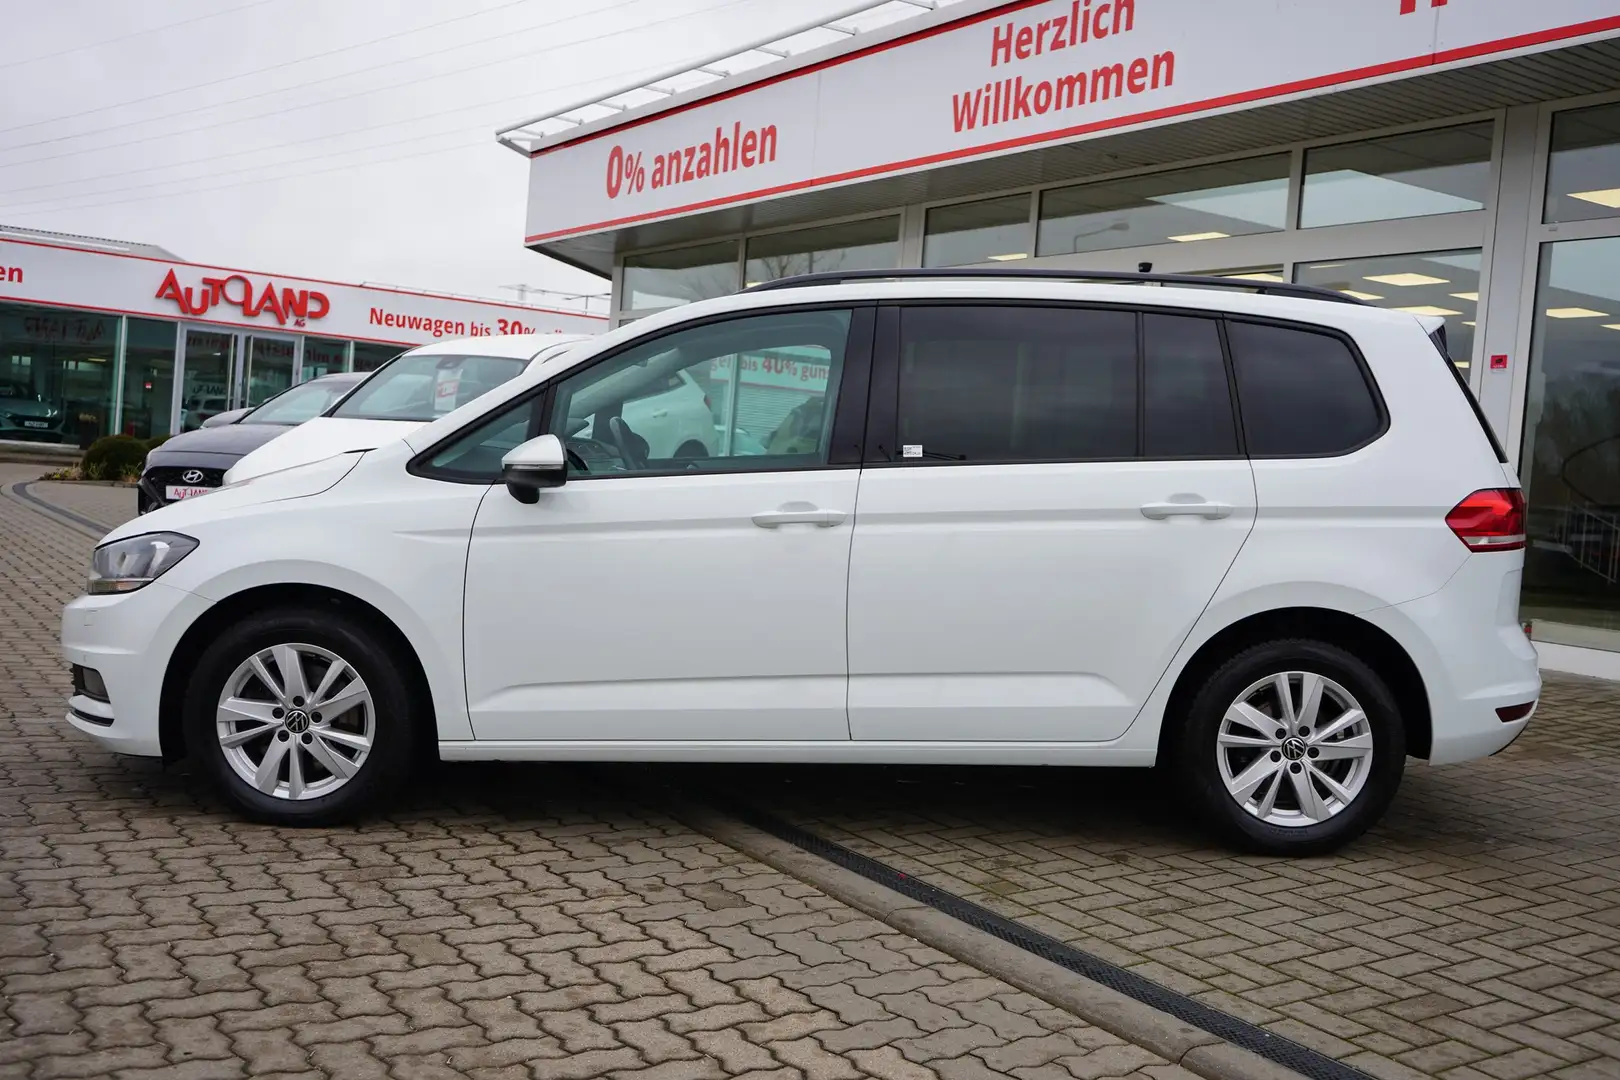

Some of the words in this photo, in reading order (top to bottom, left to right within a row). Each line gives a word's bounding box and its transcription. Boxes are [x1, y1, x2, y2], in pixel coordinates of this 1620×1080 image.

[991, 0, 1136, 67] Herzlich
[952, 50, 1175, 133] Willkommen
[606, 145, 645, 199] 0%
[652, 121, 777, 189] anzahlen
[369, 307, 465, 337] Neuwagen
[470, 321, 491, 336] bis
